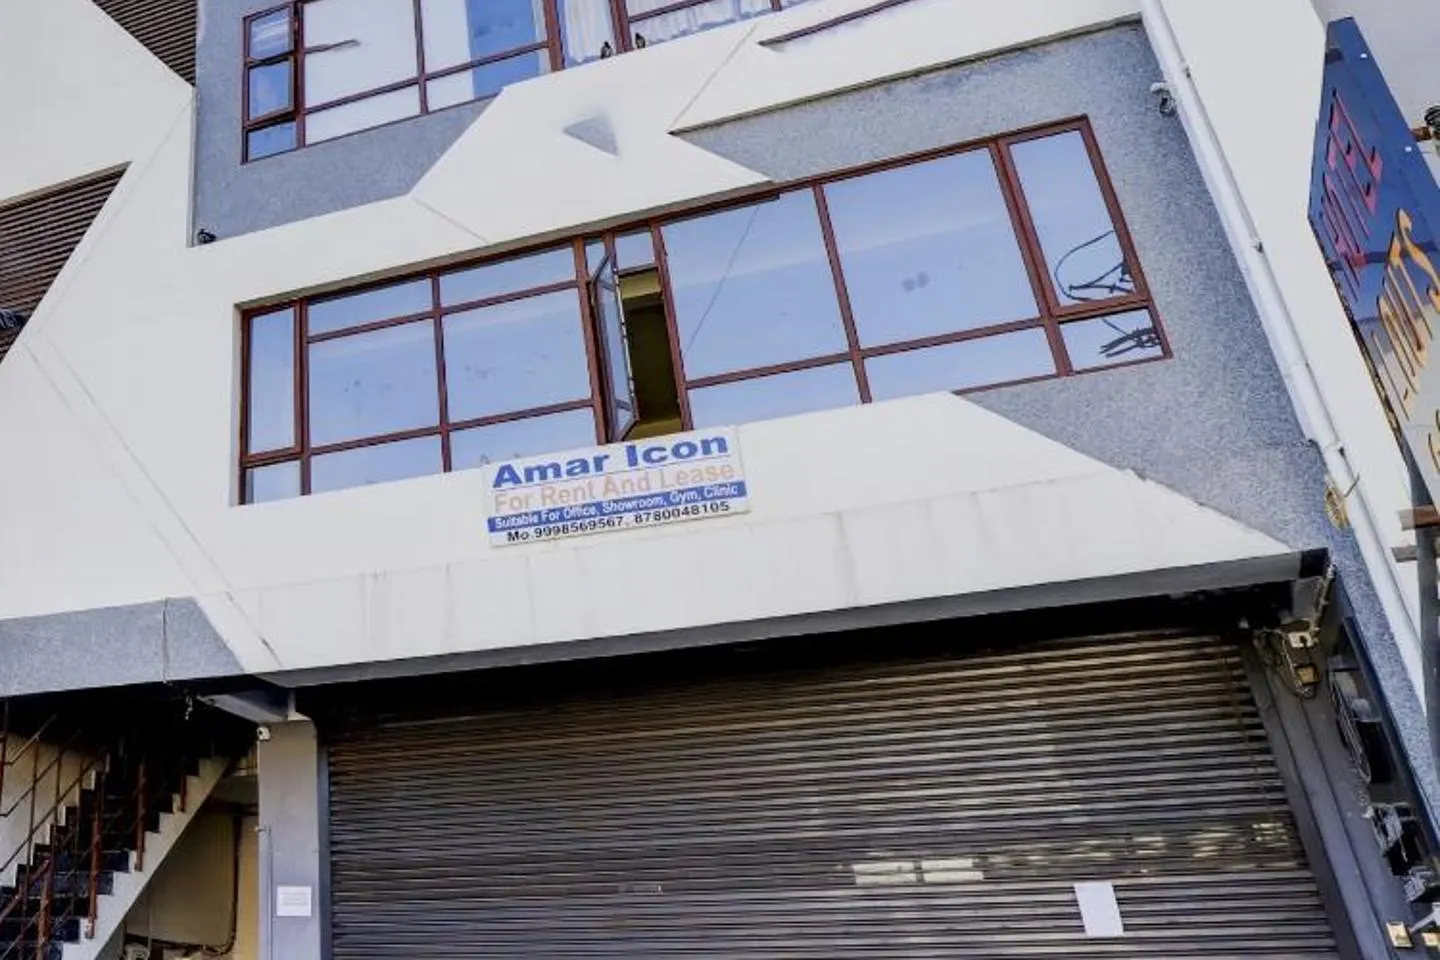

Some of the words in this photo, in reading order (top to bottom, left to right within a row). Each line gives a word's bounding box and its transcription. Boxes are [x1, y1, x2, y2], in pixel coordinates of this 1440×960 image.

[493, 455, 610, 488] Amar
[626, 436, 728, 467] Icon
[494, 493, 533, 514] For
[541, 482, 595, 506] Rent
[603, 474, 651, 497] And
[660, 464, 736, 489] Lease
[495, 515, 538, 528] Suitable
[541, 510, 560, 521] For
[562, 506, 599, 519] Office,
[602, 495, 667, 513] Showroom,
[669, 490, 702, 505] Gym,
[704, 483, 739, 497] Clinic
[633, 500, 730, 524] 8780048105
